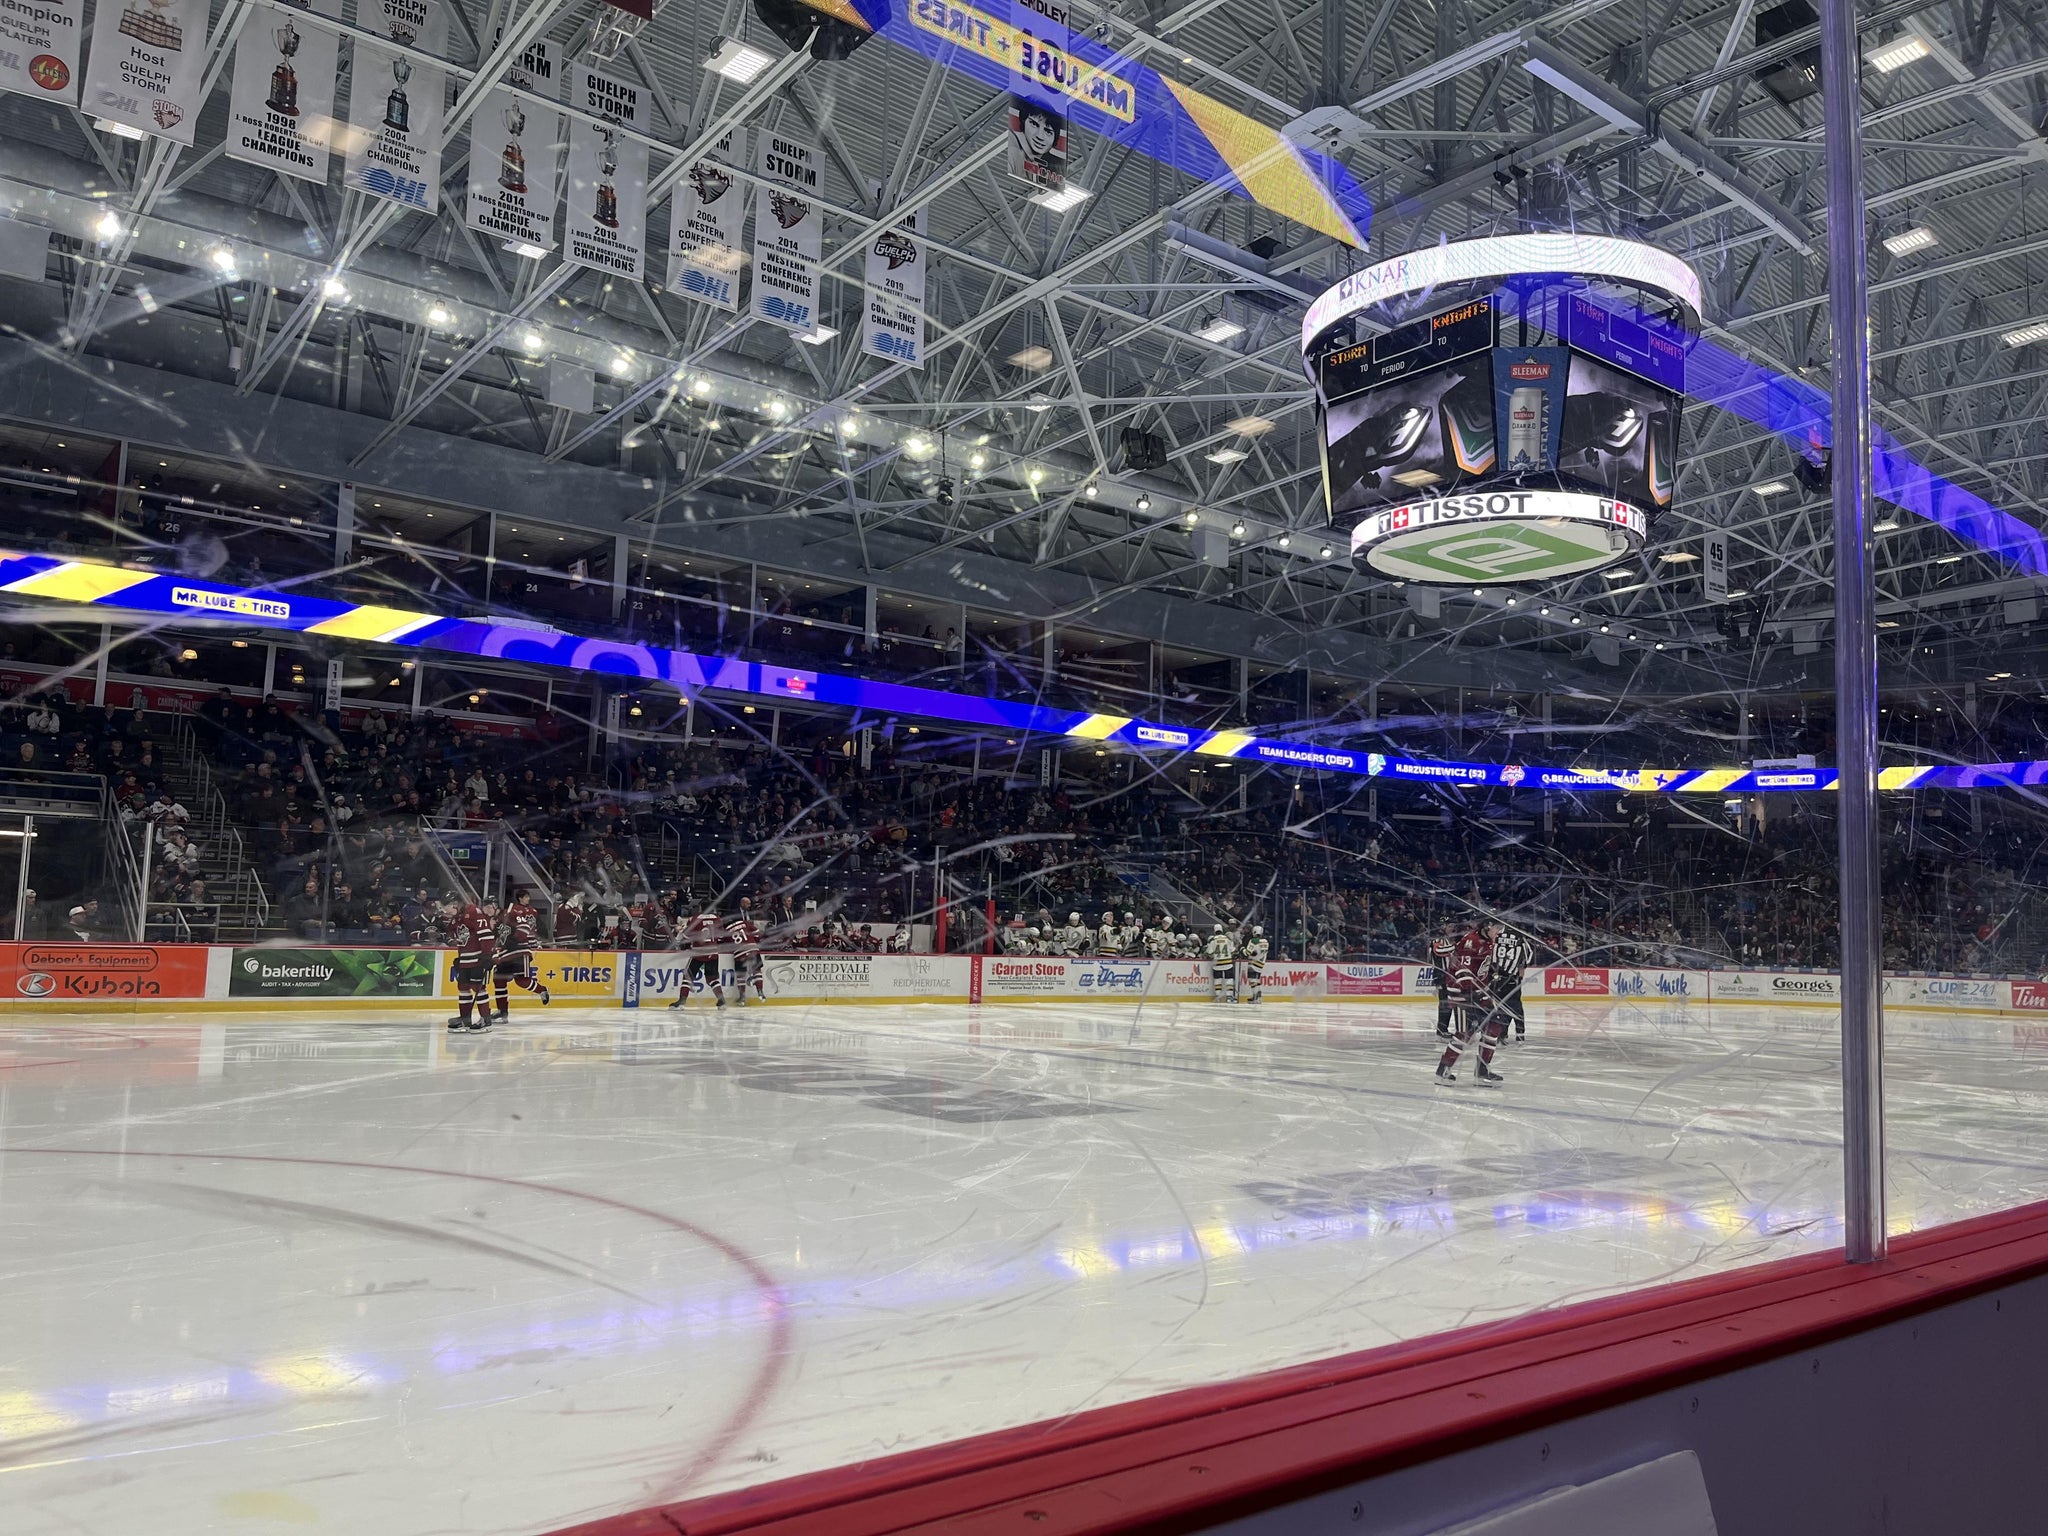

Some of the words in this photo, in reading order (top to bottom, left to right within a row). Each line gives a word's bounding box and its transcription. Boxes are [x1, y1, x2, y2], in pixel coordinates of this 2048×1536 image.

[386, 0, 427, 15] UELPH
[1, 16, 50, 36] GUELPH
[384, 8, 424, 26] STORM
[131, 46, 165, 67] Host
[120, 61, 171, 84] GUELPH
[122, 73, 166, 94] STORM
[587, 74, 636, 104] GUELPH
[588, 92, 634, 120] STORM
[242, 116, 263, 127] ROSS
[264, 122, 308, 141] ROBERTSON
[266, 112, 296, 130] 1998
[258, 129, 301, 151] LEAGUE
[385, 128, 407, 142] 2004
[242, 137, 314, 167] CHAMPIONS
[379, 143, 411, 161] LEAGUE
[772, 138, 812, 164] GUELPH
[367, 150, 420, 174] CHAMPIONS
[766, 153, 817, 187] STORM
[358, 166, 428, 208] OHL
[499, 191, 525, 207] 2014
[479, 195, 497, 205] ROSS
[498, 202, 536, 219] ROBERTSON
[536, 213, 550, 222] CUP
[492, 207, 530, 227] LEAGUE
[697, 210, 717, 224] 2004
[479, 215, 541, 242] CHAMPIONS
[576, 231, 592, 240] ROSS
[594, 226, 617, 240] 2019
[687, 219, 724, 240] WESTERN
[757, 240, 775, 250] WAYNE
[778, 236, 799, 250] 2014
[574, 246, 634, 273] CHAMPIONS
[875, 243, 915, 262] GUELPH
[767, 252, 806, 272] WESTERN
[760, 262, 812, 286] CONFERENCE
[677, 268, 731, 304] OHL
[761, 274, 811, 297] CHAMPIONS
[885, 278, 904, 291] 2019
[757, 295, 811, 328] OHL
[1433, 300, 1489, 331] KNIGHTS
[1576, 301, 1604, 323] STORM
[871, 314, 915, 335] CHAMPIONS
[870, 332, 917, 361] OHL
[1437, 336, 1447, 347] TO
[1650, 335, 1683, 361] KNIGHTS
[1330, 346, 1367, 366] STORM
[1615, 350, 1633, 365] PERIOD
[1359, 364, 1369, 373] TO
[1381, 361, 1405, 376] PERIOD
[1512, 366, 1549, 376] SLEEMAN
[1412, 493, 1533, 525] TISSOT
[165, 522, 180, 533] 26
[1711, 542, 1723, 561] 45
[526, 583, 538, 593] 24
[177, 591, 202, 603] MR.
[205, 595, 236, 609] LUBE
[251, 602, 287, 616] TIRES
[632, 601, 643, 610] 23
[782, 626, 793, 635] 22
[1172, 735, 1187, 743] TIRES
[1259, 746, 1283, 759] TEAM
[1284, 750, 1324, 763] LEADERS
[1326, 753, 1353, 768] (DEF)
[1396, 764, 1466, 777] H.BRZUSTEWICZ
[1469, 769, 1486, 780] (52)
[1542, 774, 1617, 784] Q.BEAUCHESNE
[732, 929, 748, 944] 81
[1215, 944, 1229, 957] 44
[1498, 946, 1515, 960] 84
[31, 953, 84, 965] Deboer's
[88, 954, 150, 968] Equipment
[799, 963, 870, 974] SPEEDVALE
[996, 963, 1033, 976] Carpet
[1036, 963, 1065, 976] Store
[1461, 955, 1471, 966] 13
[262, 964, 334, 981] bakertilly
[561, 967, 611, 982] TIRES
[1166, 972, 1209, 985] Freedom
[1240, 972, 1288, 987] Mnchu
[1348, 967, 1384, 977] LOVABLE
[64, 975, 160, 995] Kubota
[915, 979, 951, 988] HERITAGE
[1772, 977, 1833, 993] George's
[2013, 986, 2048, 1008] Tim
